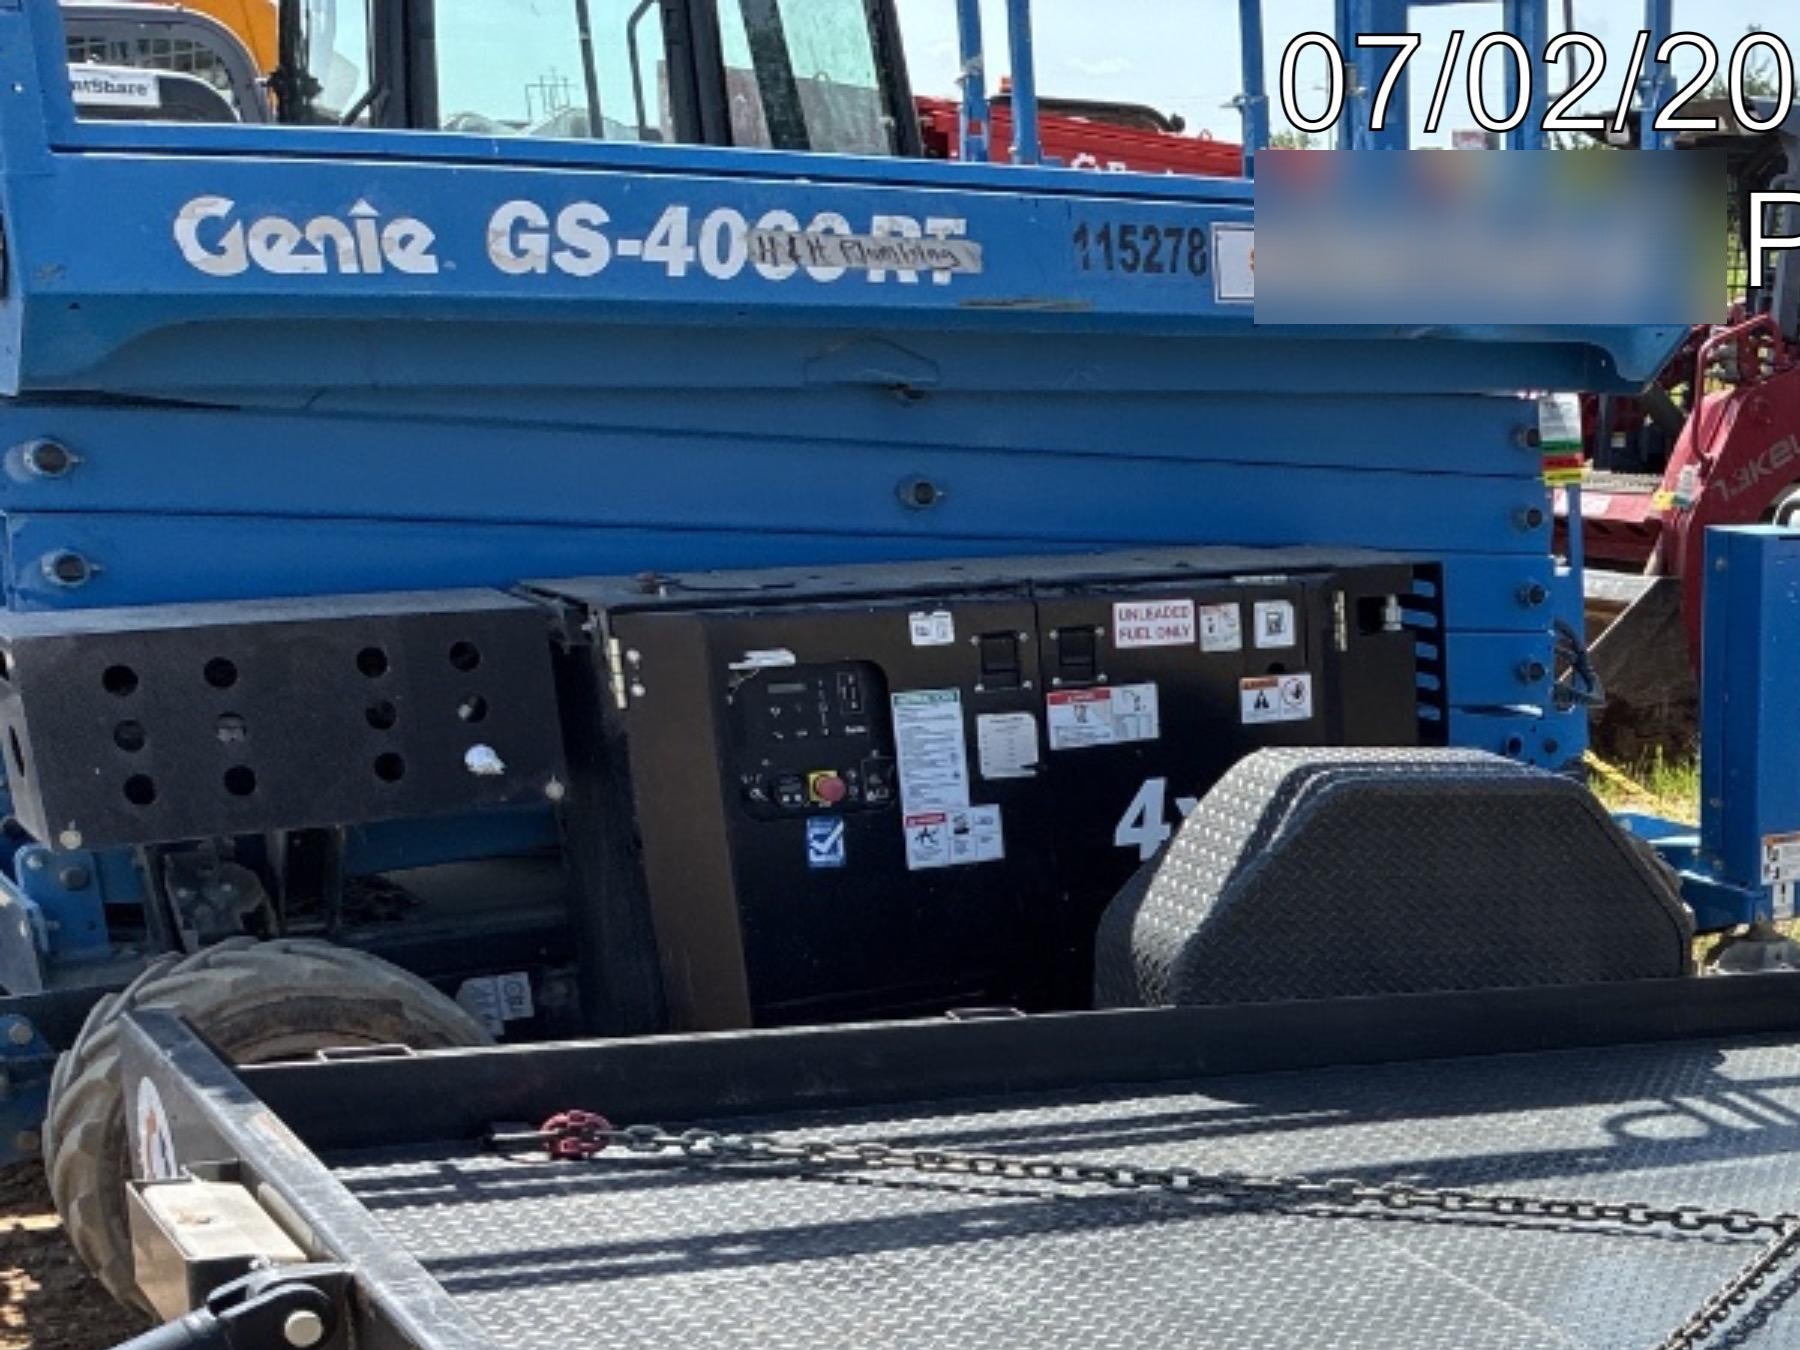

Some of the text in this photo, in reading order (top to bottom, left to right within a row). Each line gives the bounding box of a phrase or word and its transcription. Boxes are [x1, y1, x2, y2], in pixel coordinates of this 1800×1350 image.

[173, 194, 440, 276] Genie
[1073, 221, 1207, 278] 115278
[1118, 605, 1190, 622] UNLEADED
[1119, 624, 1191, 641] FUEL ONLY
